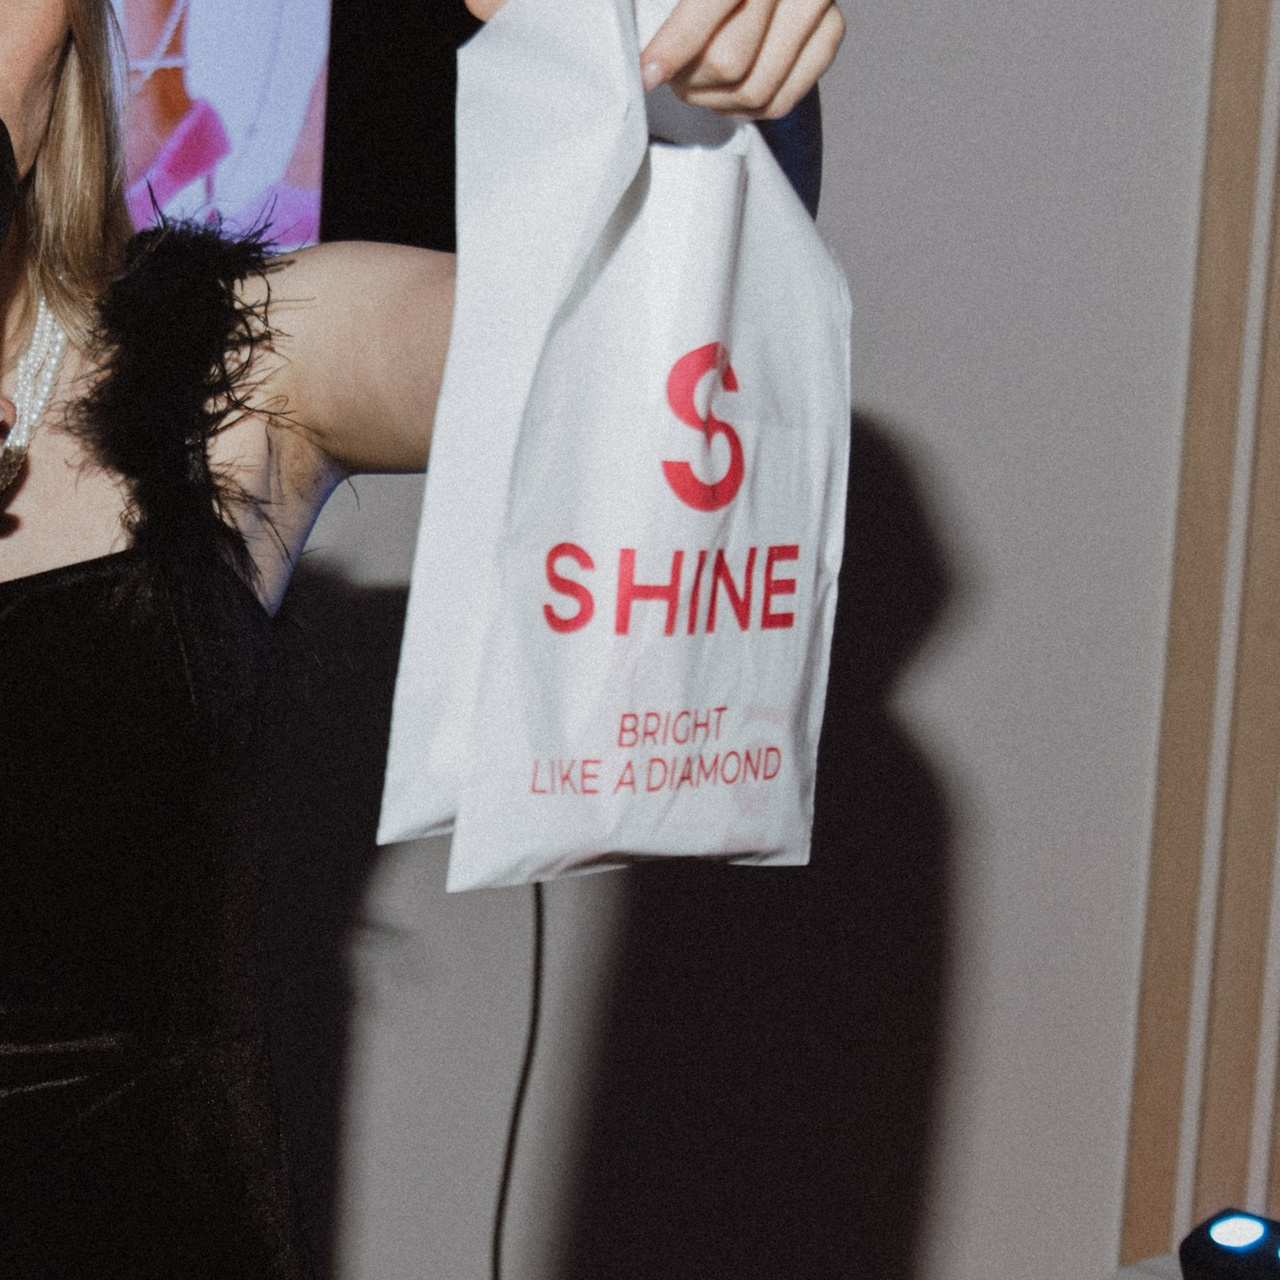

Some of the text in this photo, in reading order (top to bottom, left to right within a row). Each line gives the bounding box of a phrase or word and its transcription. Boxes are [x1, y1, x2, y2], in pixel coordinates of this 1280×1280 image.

[662, 342, 745, 512] S
[543, 542, 800, 636] SHINE
[616, 706, 729, 749] BRIGHT
[530, 746, 783, 796] LIKE A DIAMOND
